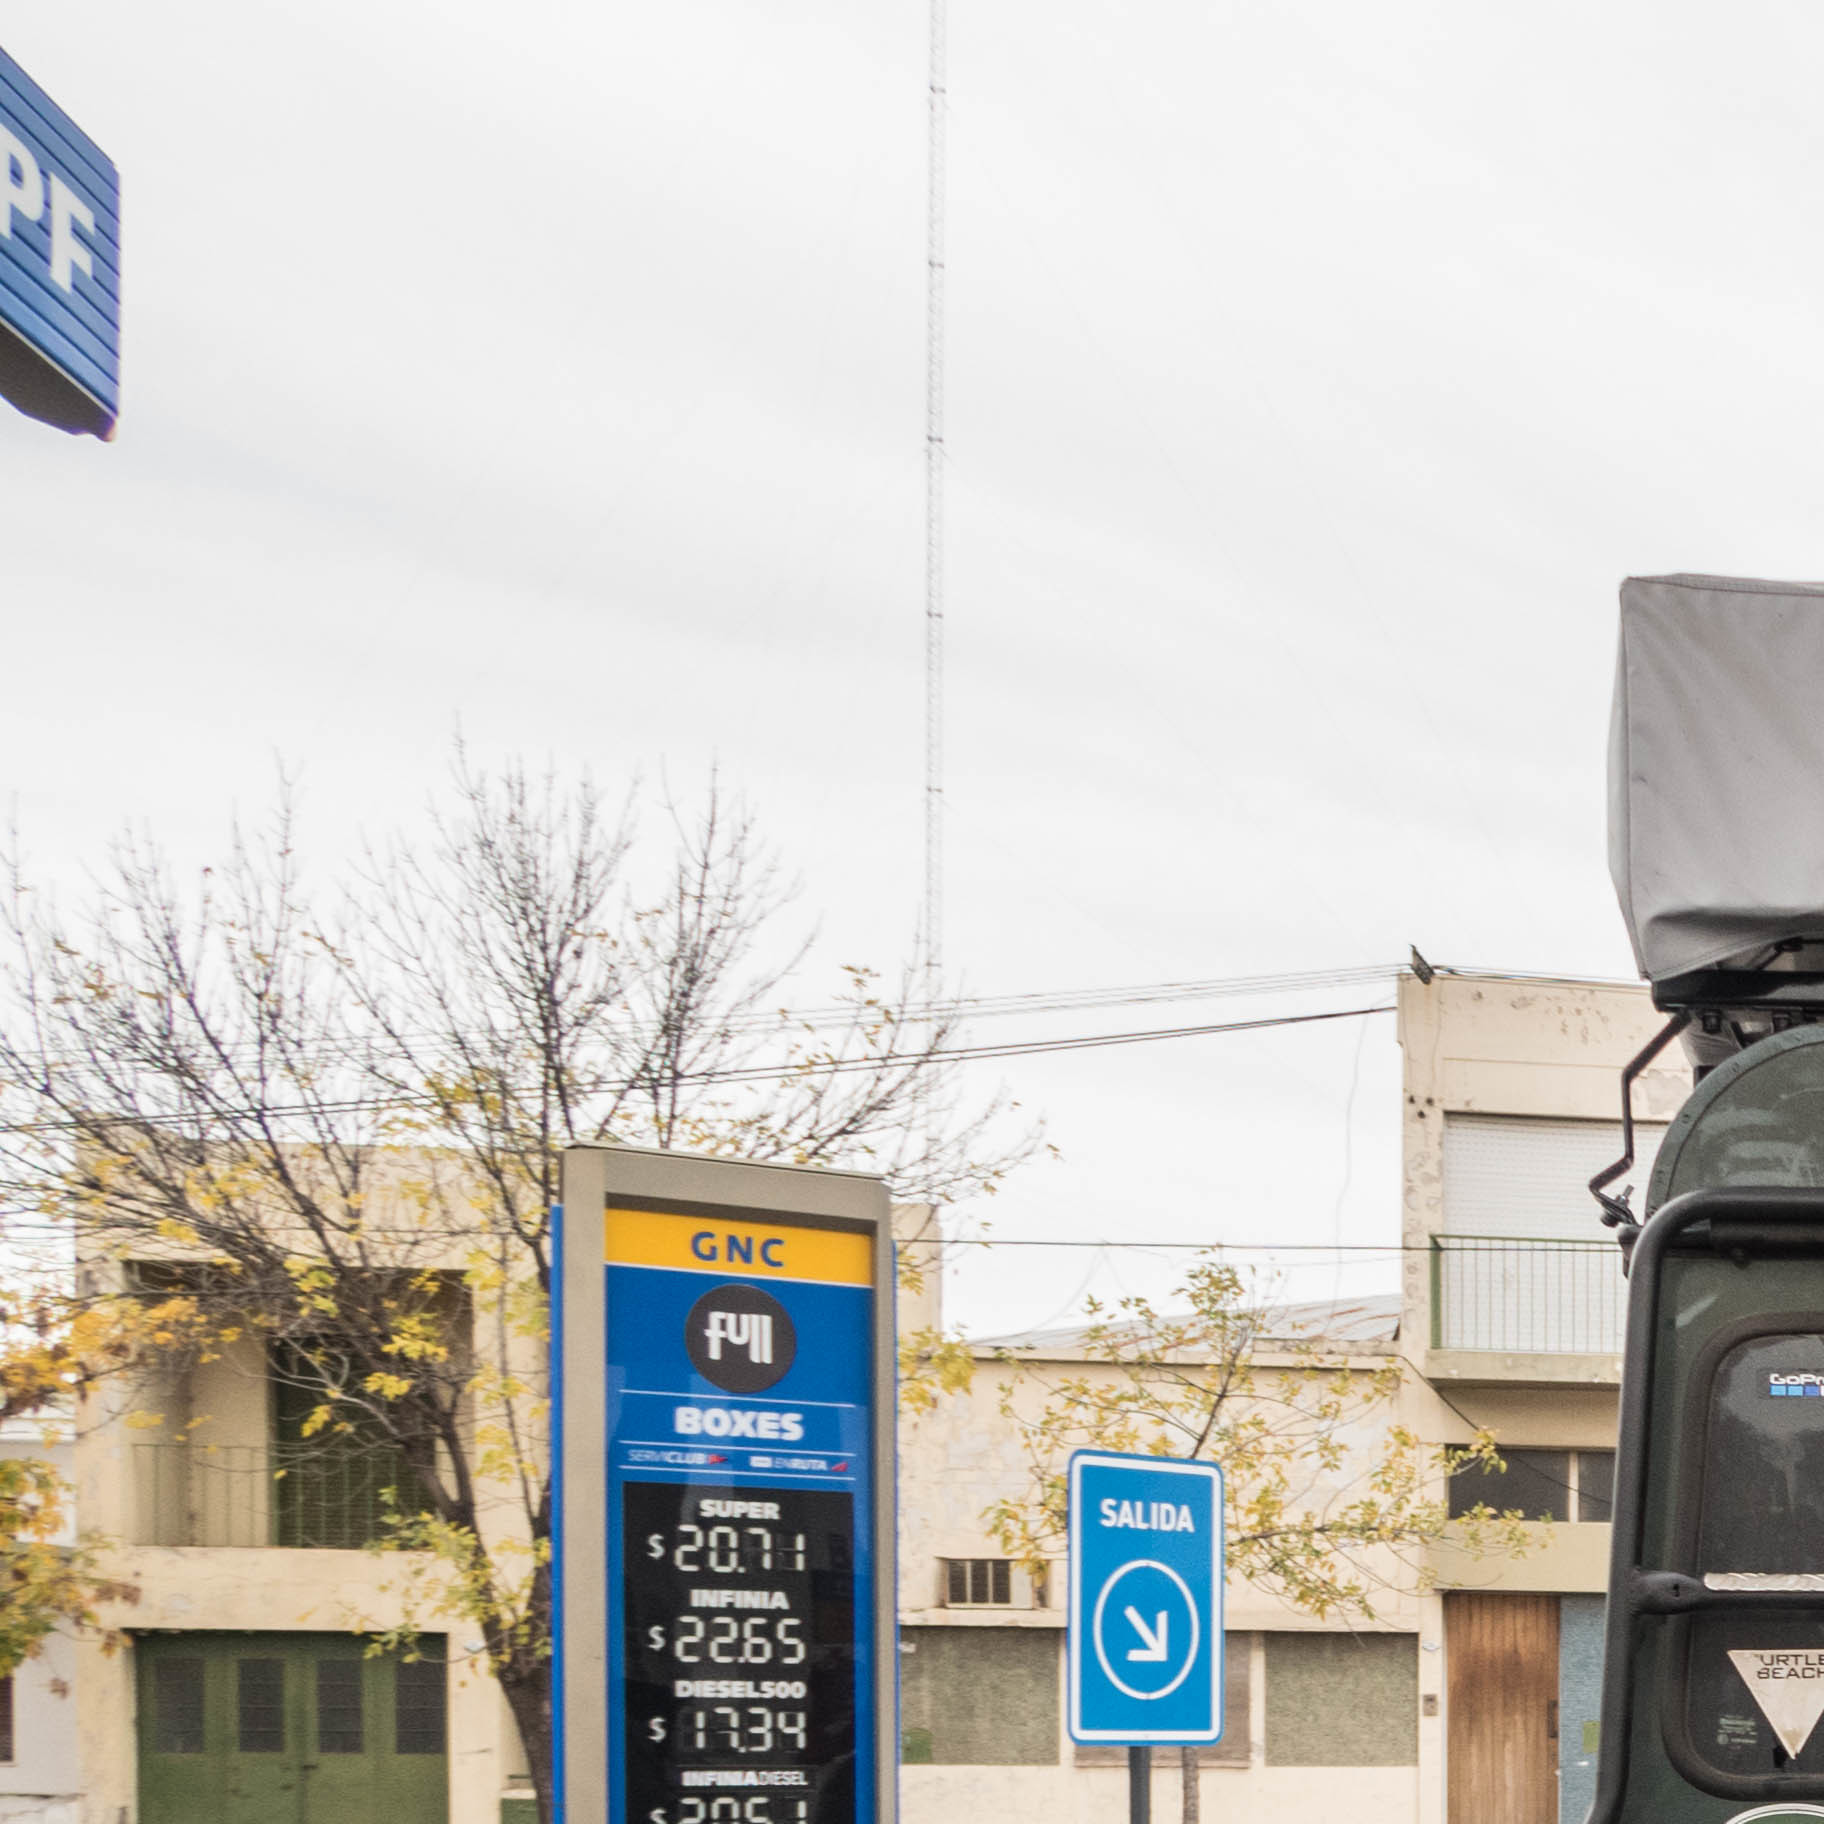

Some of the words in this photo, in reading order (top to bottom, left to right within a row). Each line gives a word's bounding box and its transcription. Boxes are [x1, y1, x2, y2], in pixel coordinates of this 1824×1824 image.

[690, 1231, 785, 1267] GNC
[675, 1406, 804, 1441] BOXES
[700, 1499, 781, 1520] SUPER
[1099, 1498, 1195, 1533] SALIDA
[674, 1524, 806, 1573] 20.71
[690, 1589, 790, 1610] INFINIA
[674, 1615, 807, 1664] 22.65
[674, 1680, 807, 1699] DIESEL500
[695, 1706, 807, 1753] 17.34
